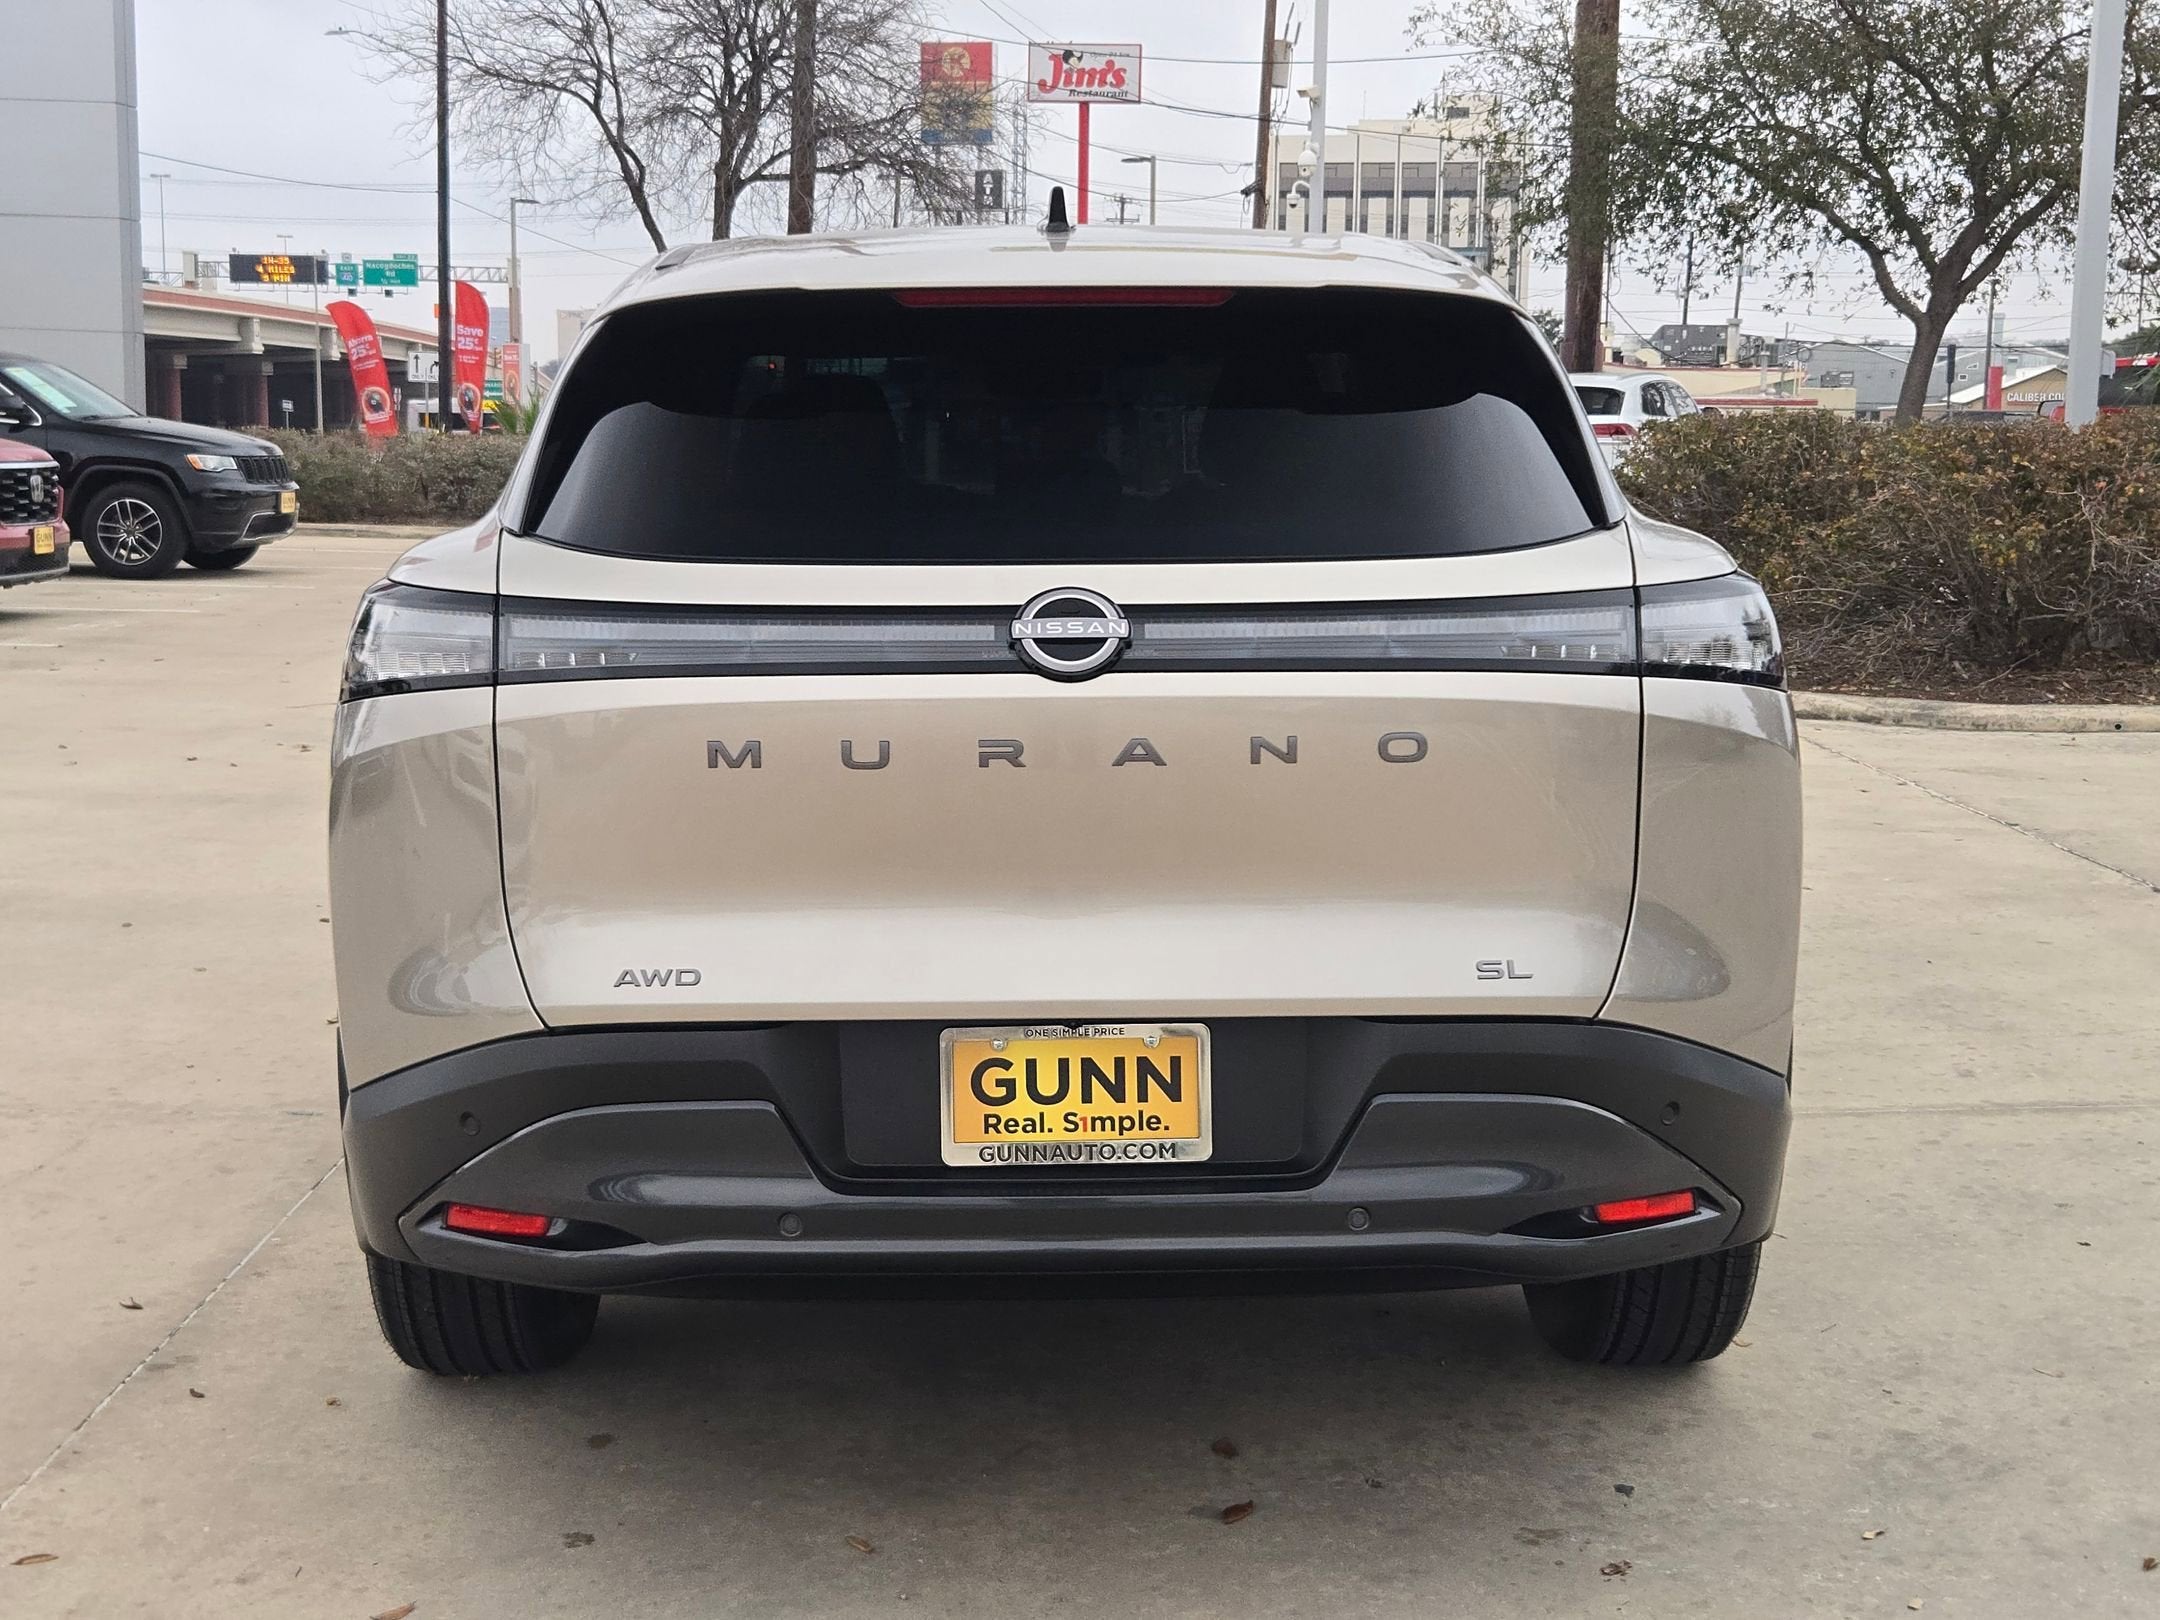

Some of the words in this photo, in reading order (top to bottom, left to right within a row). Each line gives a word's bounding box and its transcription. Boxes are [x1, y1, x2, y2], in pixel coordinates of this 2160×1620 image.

[1038, 53, 1127, 94] Jim's
[1068, 88, 1129, 98] Restaurant
[982, 173, 994, 207] ATM
[268, 265, 295, 273] MILES
[456, 324, 484, 337] Save
[2007, 392, 2046, 402] CALIBER
[1014, 621, 1126, 635] NISSAN
[706, 731, 1430, 770] MURANO
[613, 968, 702, 987] AWD
[1475, 959, 1534, 980] SL
[1025, 1028, 1048, 1037] ONE
[1051, 1027, 1090, 1037] SIMPLE
[1094, 1027, 1125, 1036] PRICE
[970, 1055, 1183, 1107] GUNN
[983, 1112, 1053, 1135] Real.
[978, 1142, 1177, 1163] GUNNAUTO.COM
